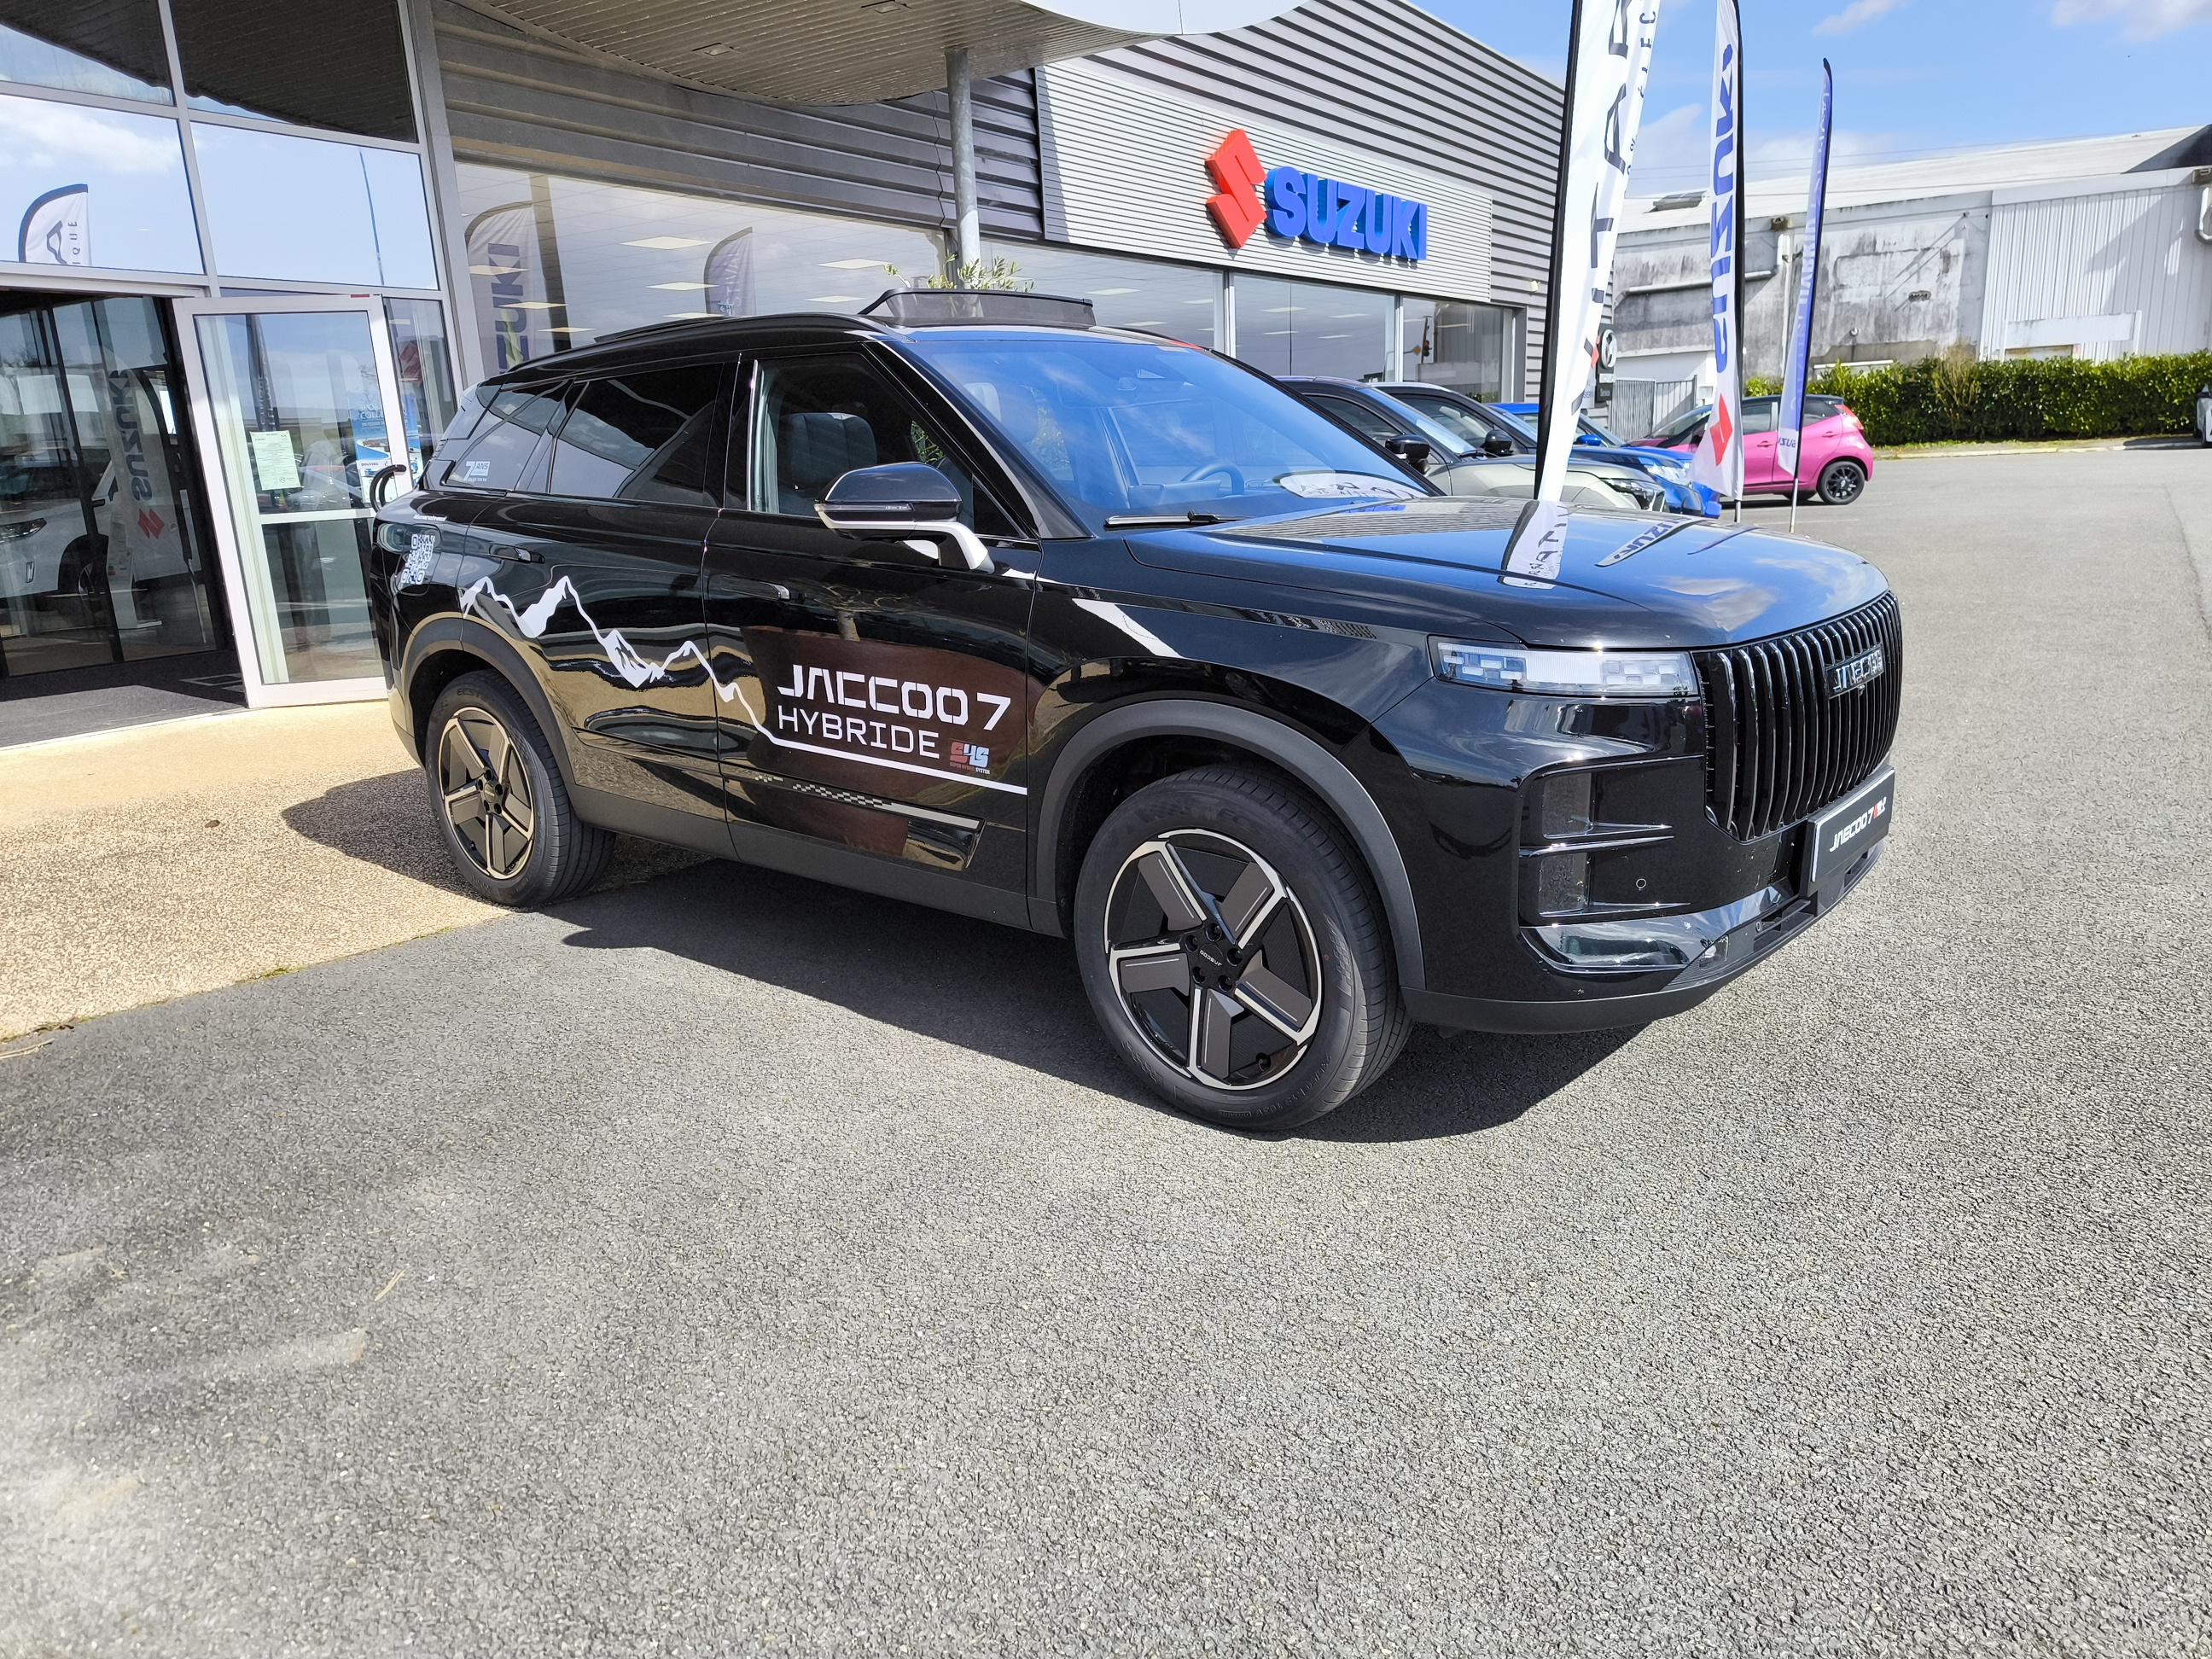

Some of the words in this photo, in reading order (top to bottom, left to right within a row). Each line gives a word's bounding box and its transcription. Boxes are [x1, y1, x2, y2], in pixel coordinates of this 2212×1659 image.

[1265, 166, 1429, 261] SUZUKI
[777, 705, 940, 760] HYBRIDE
[976, 692, 1011, 731] 7
[1829, 812, 1868, 853] JAECOO
